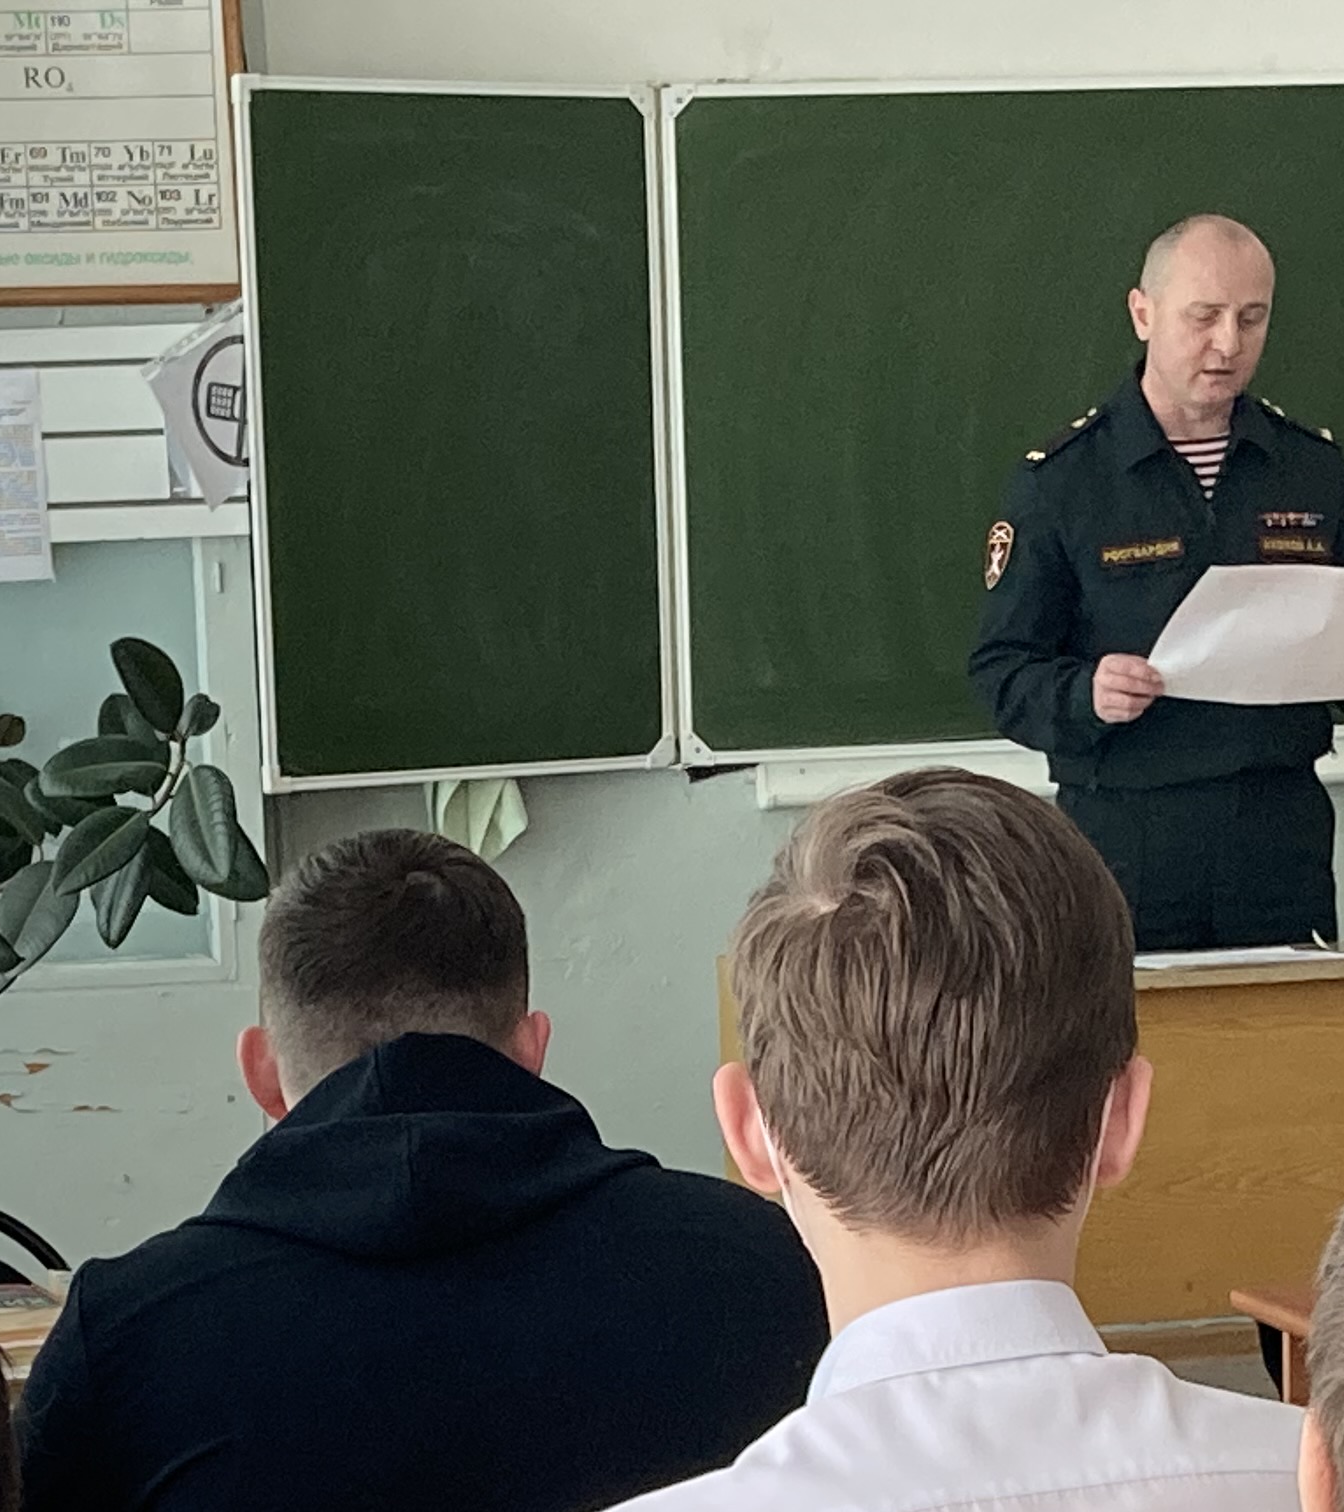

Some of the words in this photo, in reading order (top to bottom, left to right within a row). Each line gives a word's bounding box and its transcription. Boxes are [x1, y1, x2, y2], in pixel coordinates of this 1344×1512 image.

[13, 10, 41, 30] Mt
[49, 14, 71, 28] 110
[99, 10, 125, 29] Ds
[0, 146, 22, 165] Er
[58, 144, 86, 164] Tm
[93, 144, 112, 158] 70
[123, 144, 150, 163] Yb
[157, 143, 173, 157] 71
[189, 142, 213, 162] Lu
[30, 191, 50, 204] 101
[58, 190, 89, 209] Md
[95, 190, 118, 203] 102
[127, 189, 153, 208] No
[158, 188, 182, 202] 103
[193, 187, 217, 207] Lr
[85, 252, 95, 264] и
